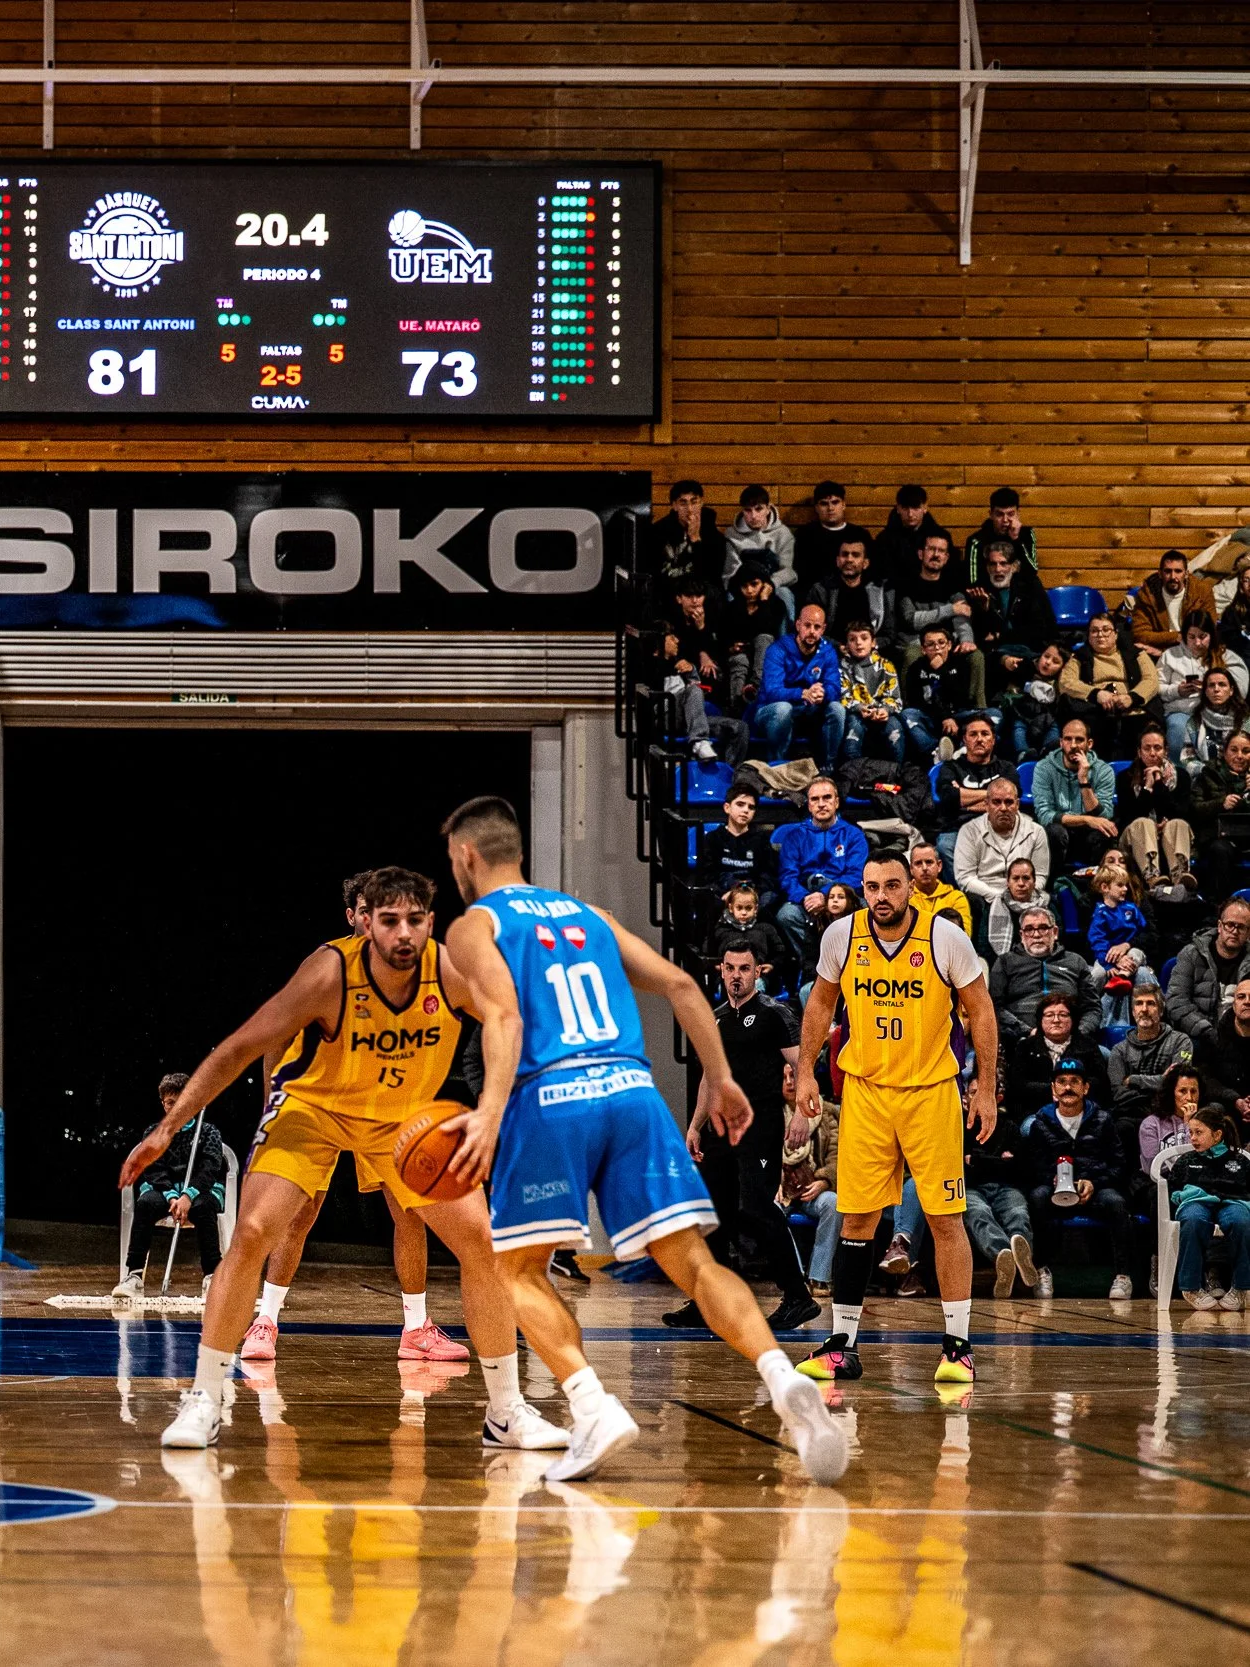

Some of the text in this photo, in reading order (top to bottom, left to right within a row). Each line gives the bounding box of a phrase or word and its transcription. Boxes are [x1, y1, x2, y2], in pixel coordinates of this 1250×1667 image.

[18, 178, 38, 187] PTS
[556, 181, 619, 190] FALTAS PTS
[538, 196, 546, 206] 0
[538, 212, 546, 222] 2
[24, 226, 36, 236] 11
[235, 213, 329, 246] 20.4
[538, 228, 546, 238] 5
[70, 232, 184, 261] SANT ANTONI
[388, 248, 492, 283] UEM
[243, 269, 321, 280] PERIODO 4
[216, 298, 234, 308] TM
[532, 292, 546, 303] 15
[330, 299, 348, 309] TM
[23, 307, 37, 317] 17
[531, 308, 544, 318] 21
[29, 322, 37, 333] 2
[58, 319, 195, 330] CLASS SANT ANTONI
[399, 318, 481, 332] UE. MATARÓ
[531, 325, 545, 334] 22
[260, 346, 302, 356] FALTAS
[531, 341, 620, 352] 50 14
[220, 344, 236, 362] 5
[329, 344, 345, 362] 5
[88, 349, 157, 396] 81
[260, 365, 302, 386] 2-5
[402, 351, 478, 397] 73
[179, 692, 229, 702] SALIDA
[855, 977, 924, 999] HOMS
[545, 961, 620, 1045] 10
[876, 1017, 902, 1040] 50
[351, 1026, 441, 1052] HOMS
[378, 1067, 406, 1088] 15
[944, 1178, 964, 1201] 50
